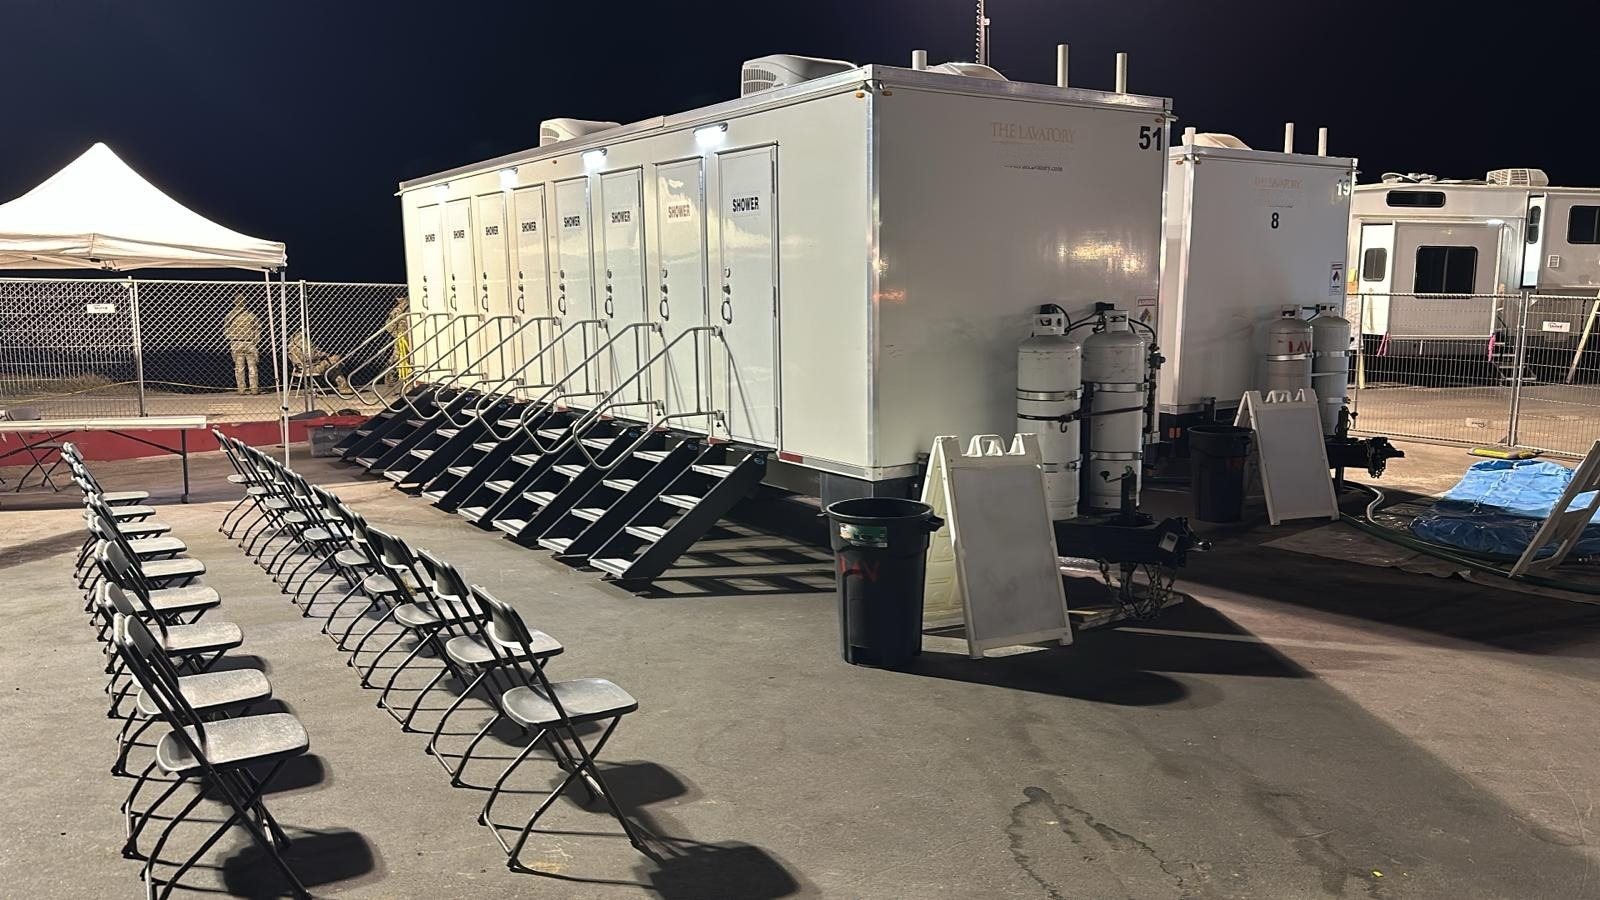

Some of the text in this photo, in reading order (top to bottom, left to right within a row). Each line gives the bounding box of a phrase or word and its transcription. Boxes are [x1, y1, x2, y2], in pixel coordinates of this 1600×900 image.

[991, 122, 1076, 144] THE LAVATORY
[1138, 126, 1162, 151] 51
[1336, 181, 1351, 196] 19
[668, 204, 690, 218] SHOWER
[732, 197, 759, 212] SHOWER
[563, 215, 580, 227] SHOWER
[611, 210, 631, 223] SHOWER
[1271, 212, 1279, 229] 8
[485, 225, 498, 235] SHOWER
[521, 221, 536, 232] SHOWER
